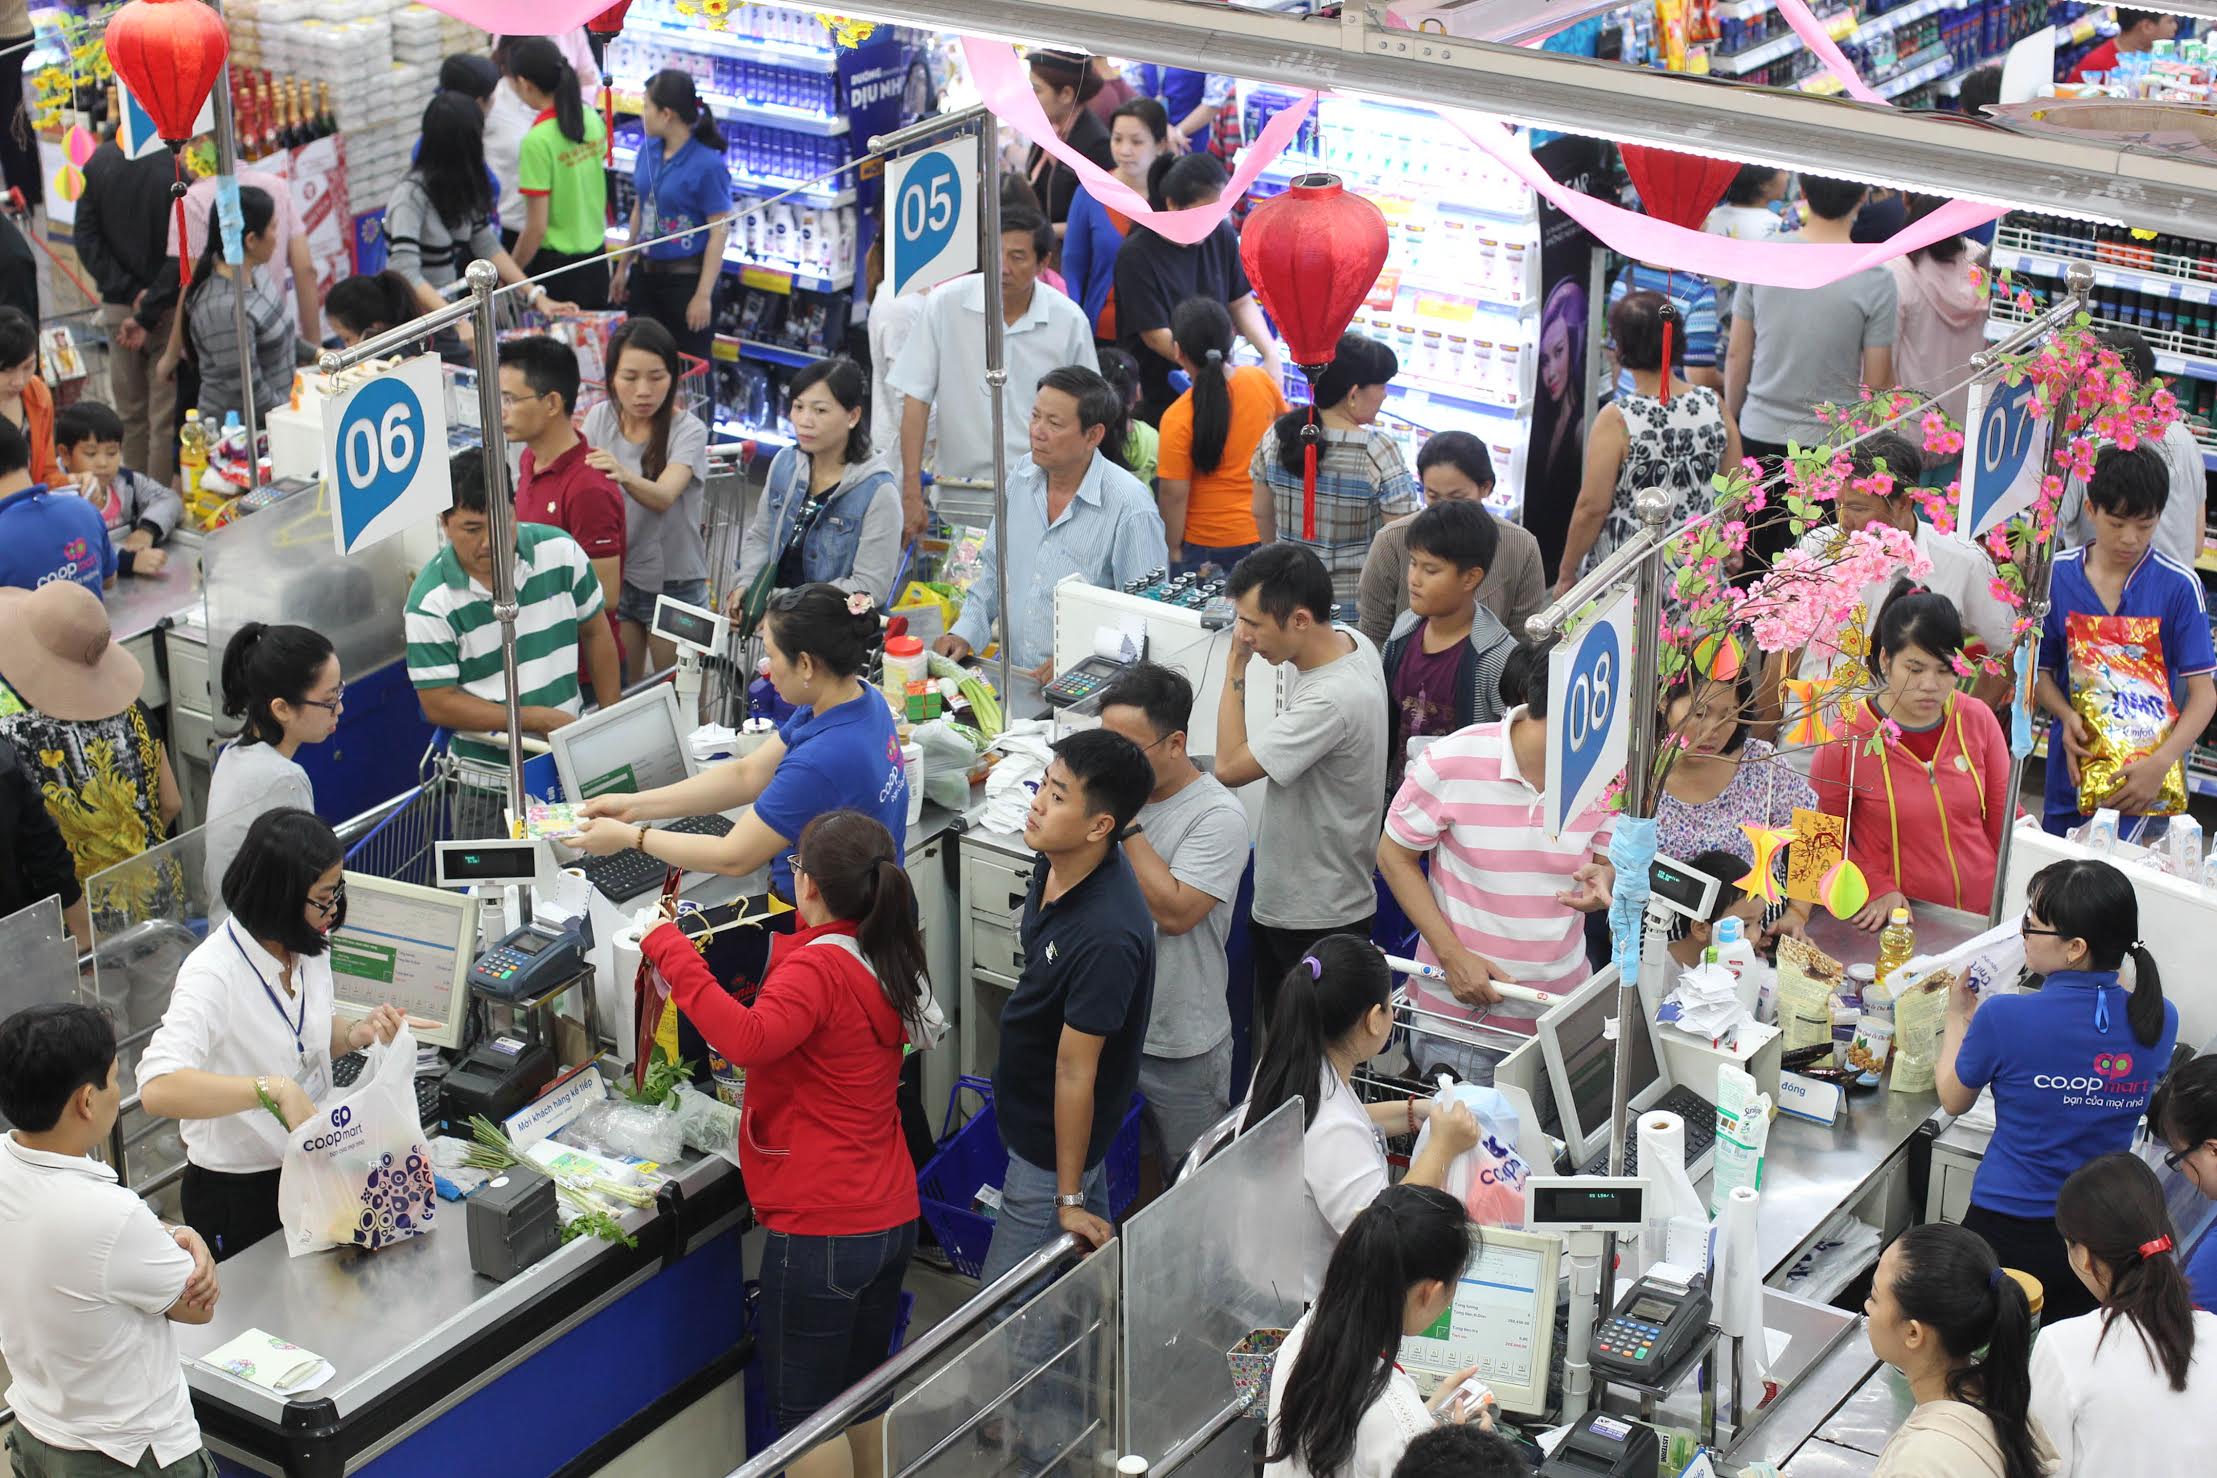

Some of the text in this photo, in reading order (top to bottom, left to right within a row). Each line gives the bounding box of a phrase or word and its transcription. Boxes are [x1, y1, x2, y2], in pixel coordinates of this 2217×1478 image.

[880, 74, 907, 100] NH
[902, 172, 952, 242] 05
[345, 402, 415, 490] 06
[1985, 389, 2033, 472] 07
[1570, 651, 1611, 752] 08
[516, 1115, 533, 1132] Mời
[532, 1105, 553, 1122] khách
[553, 1093, 572, 1109] hàng
[579, 1077, 594, 1092] tiếp
[1781, 1081, 1806, 1097] đóng
[2063, 1095, 2083, 1107] bạn
[2085, 1094, 2104, 1107] của
[2106, 1098, 2125, 1109] mọi
[303, 1123, 363, 1152] co.opmart
